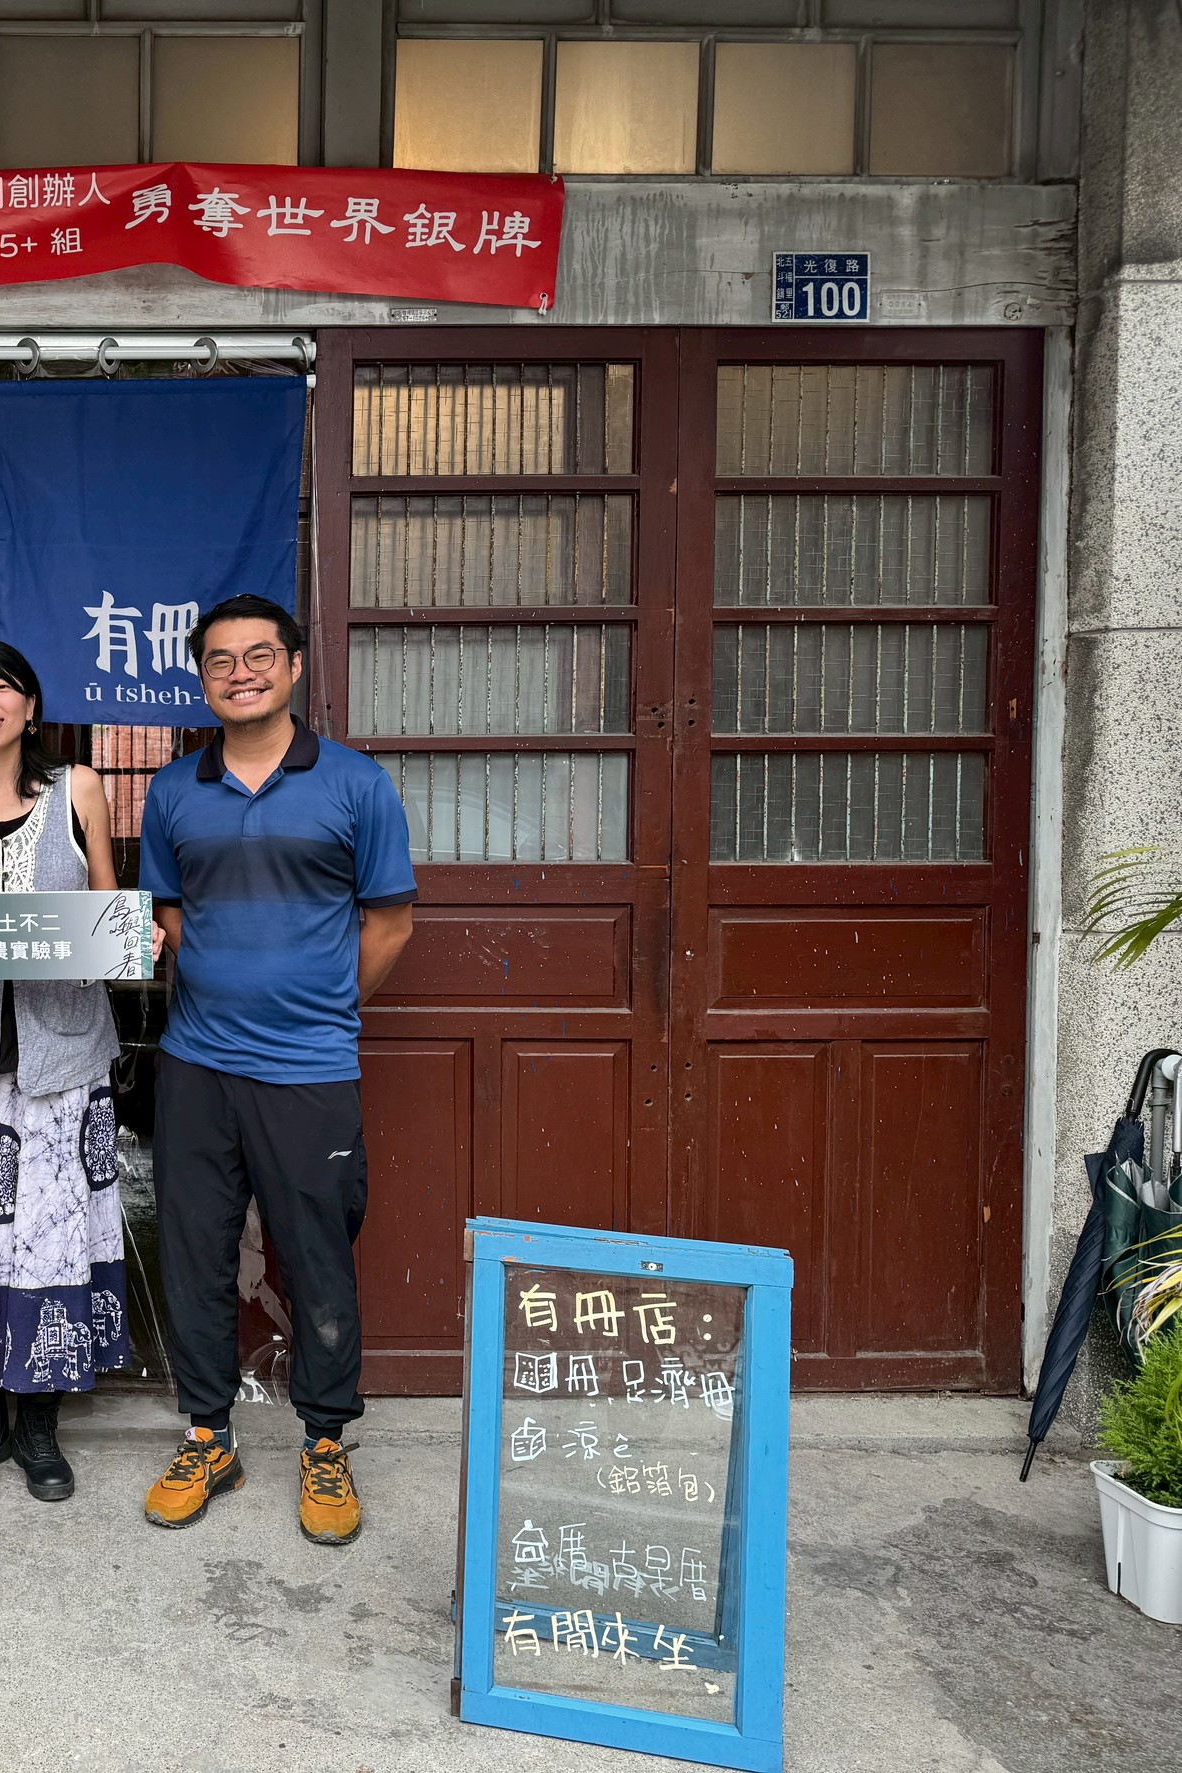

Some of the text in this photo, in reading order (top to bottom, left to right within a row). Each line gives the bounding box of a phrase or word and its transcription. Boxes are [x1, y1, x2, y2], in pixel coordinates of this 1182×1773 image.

[124, 183, 542, 258] 勇奪世界銀牌
[50, 227, 83, 256] 組
[803, 258, 860, 274] 光復路
[802, 281, 861, 317] 100
[775, 309, 792, 319] 521
[84, 682, 103, 702] ū
[501, 1608, 698, 1671] 有閒來坐
